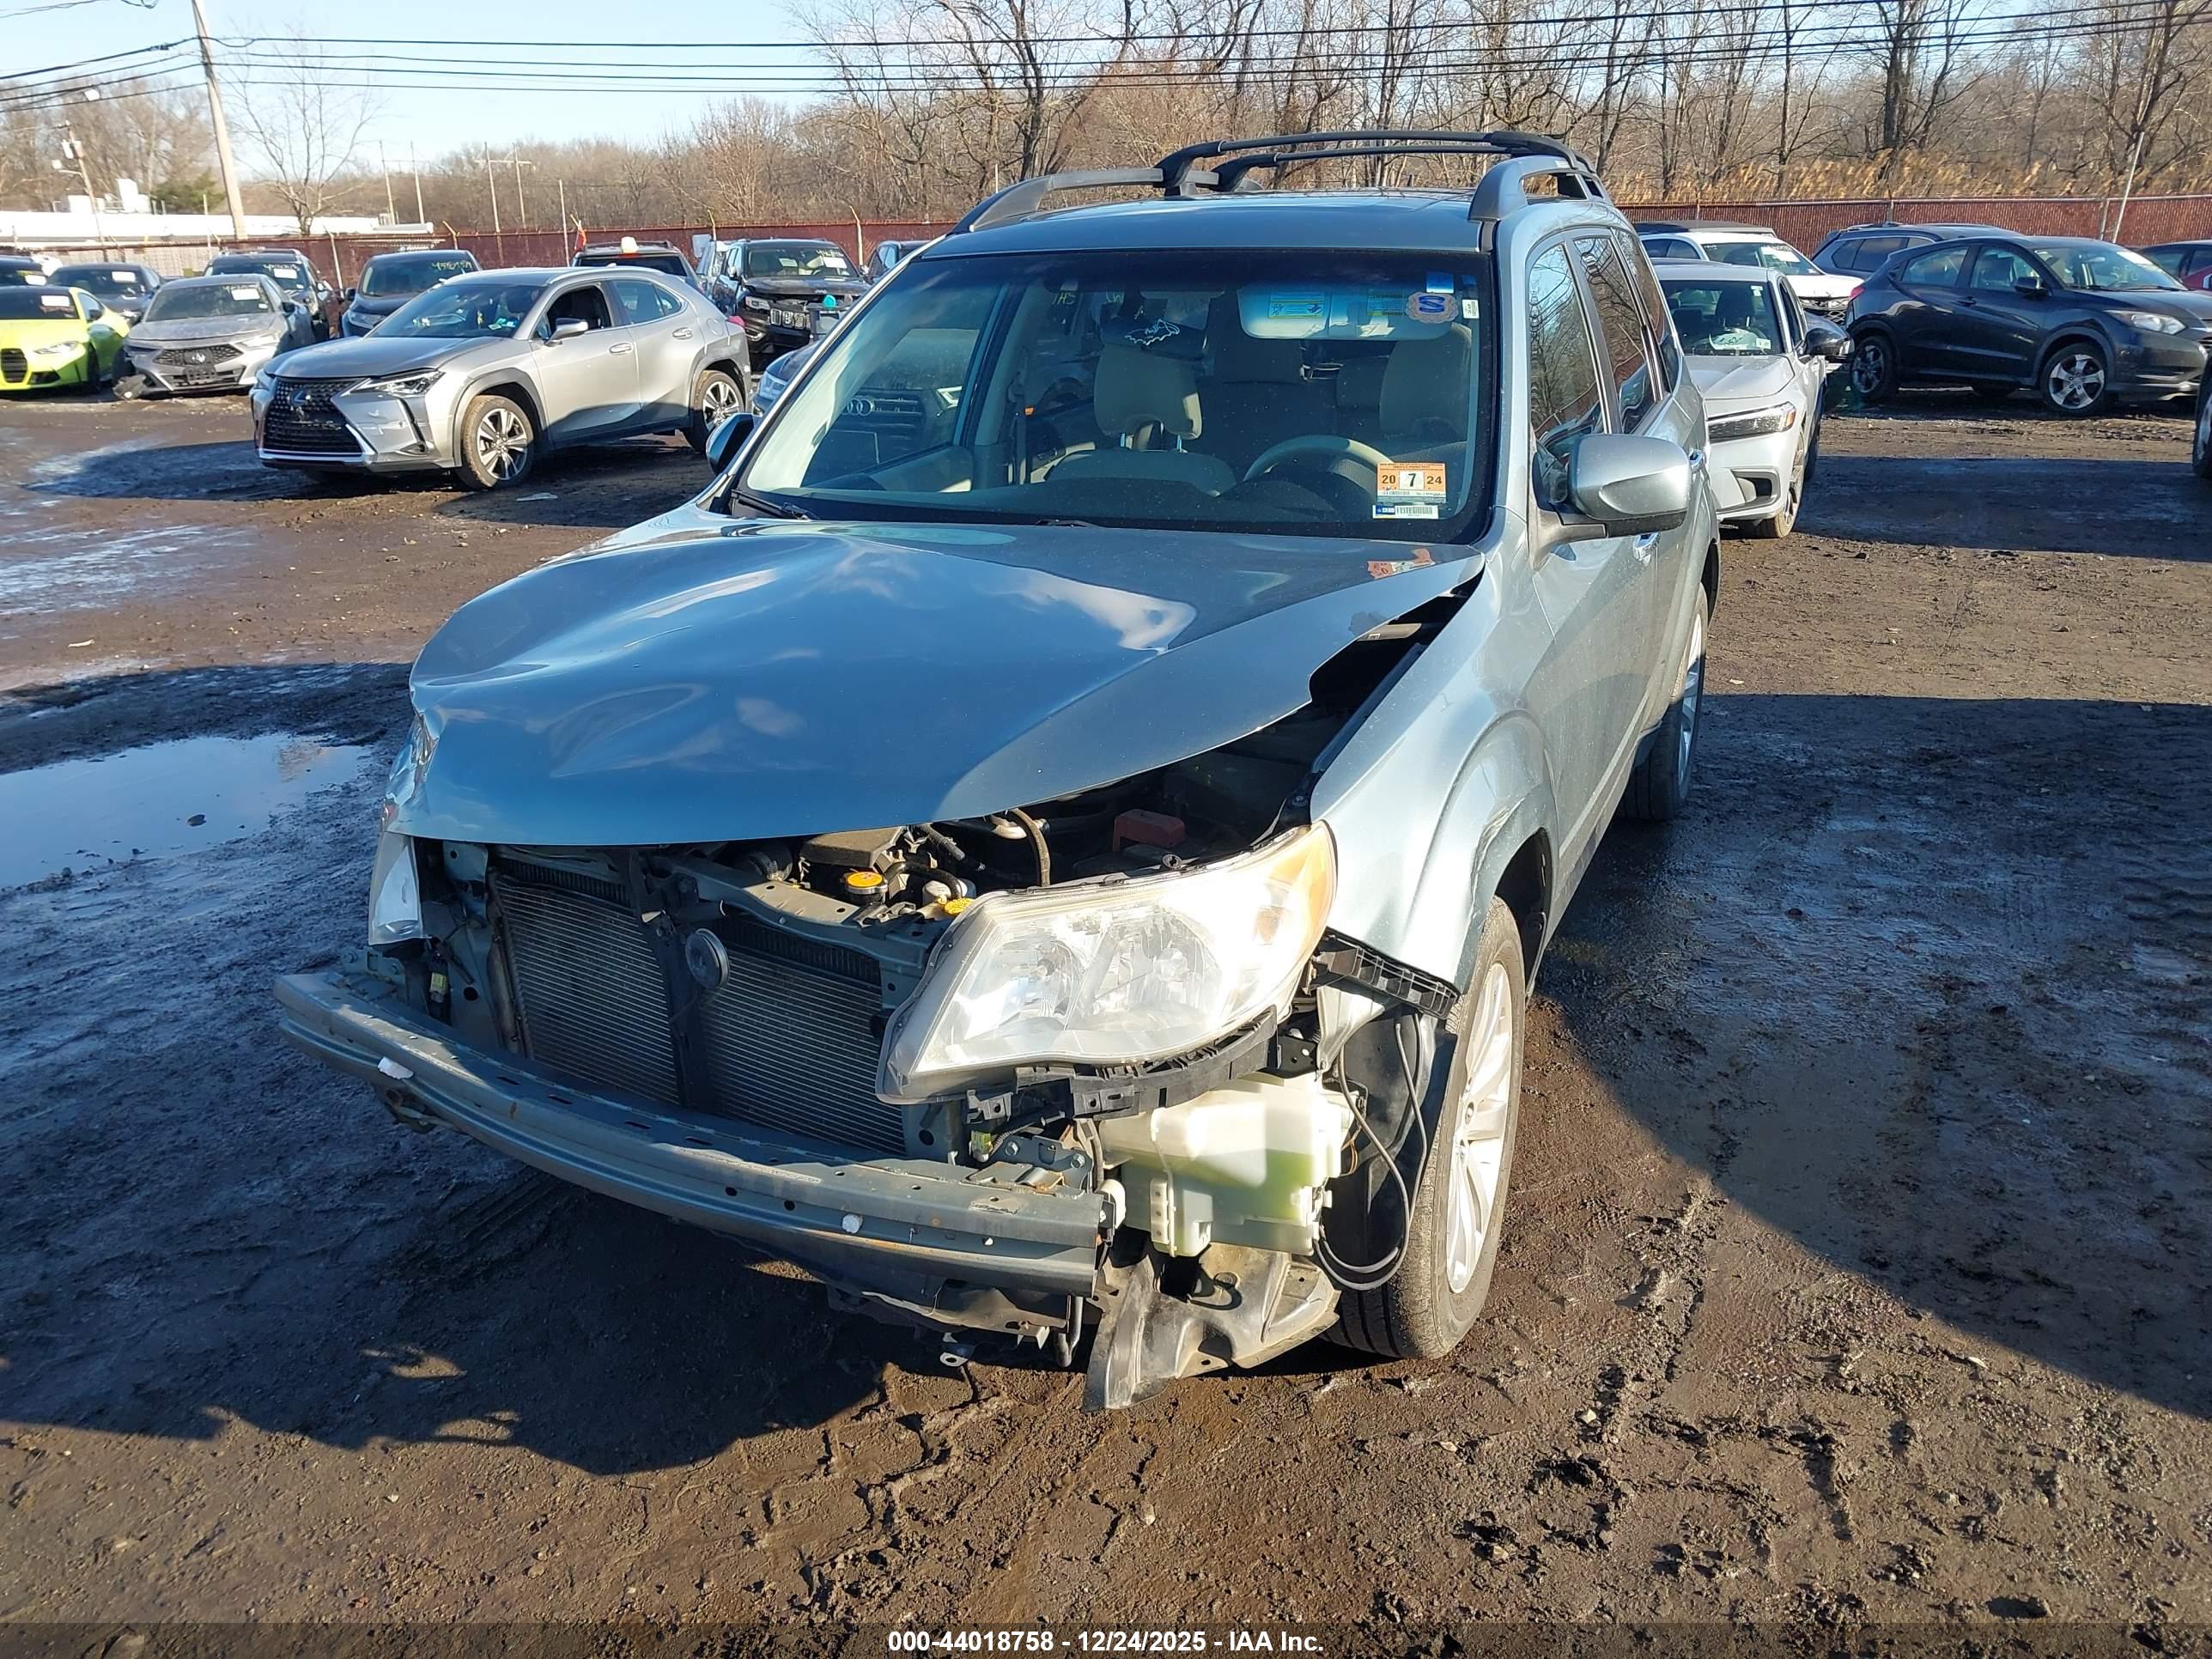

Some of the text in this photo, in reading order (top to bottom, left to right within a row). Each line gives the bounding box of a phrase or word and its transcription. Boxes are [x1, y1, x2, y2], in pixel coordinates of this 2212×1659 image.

[1382, 472, 1443, 488] 20 7 24
